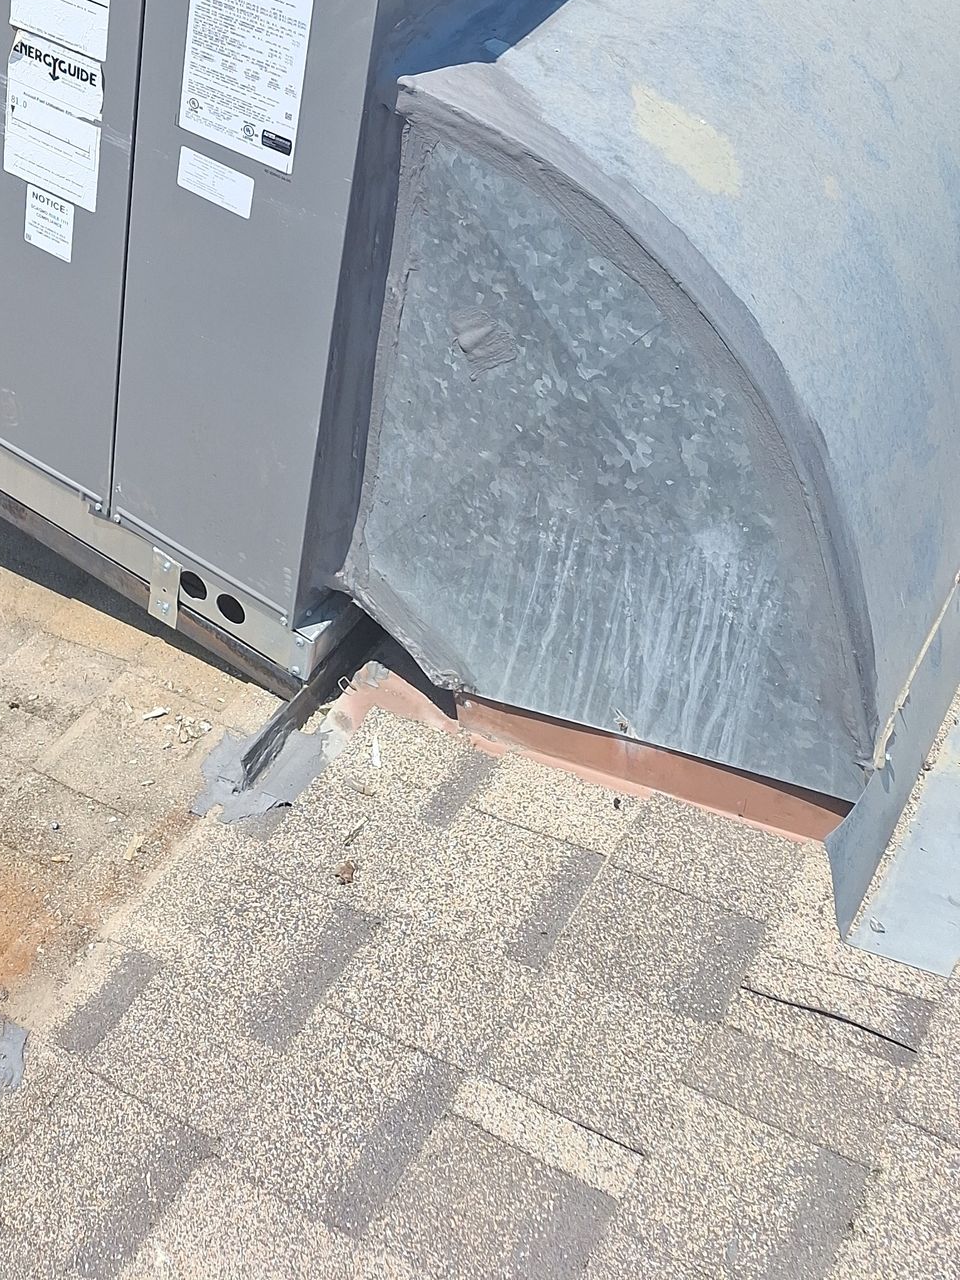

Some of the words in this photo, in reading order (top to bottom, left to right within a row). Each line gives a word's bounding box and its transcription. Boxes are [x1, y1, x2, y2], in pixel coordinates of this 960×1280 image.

[13, 42, 97, 87] ENERGYGUIDE
[10, 95, 27, 109] 81.0
[32, 190, 69, 216] NOTICE:
